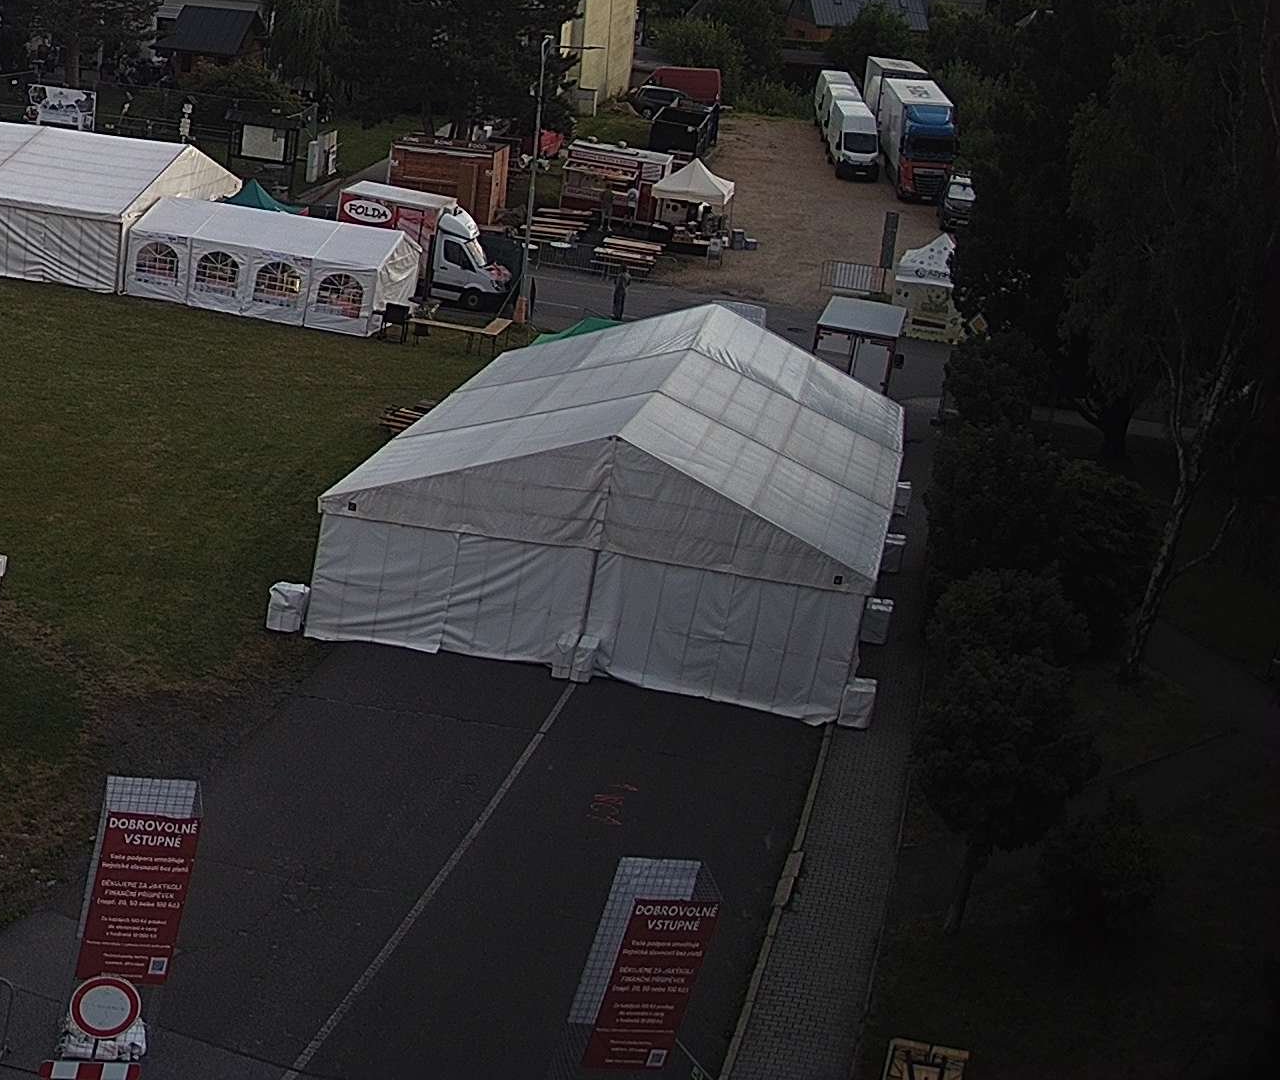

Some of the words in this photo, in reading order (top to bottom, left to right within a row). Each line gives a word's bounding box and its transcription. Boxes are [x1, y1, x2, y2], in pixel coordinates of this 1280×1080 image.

[348, 204, 388, 219] FOLDA
[109, 817, 199, 834] DOBROVOLNÉ
[124, 833, 182, 848] VSTUPNÉ
[635, 904, 719, 917] DOBROVOLNÉ
[647, 919, 701, 931] VSTUPNÉ
